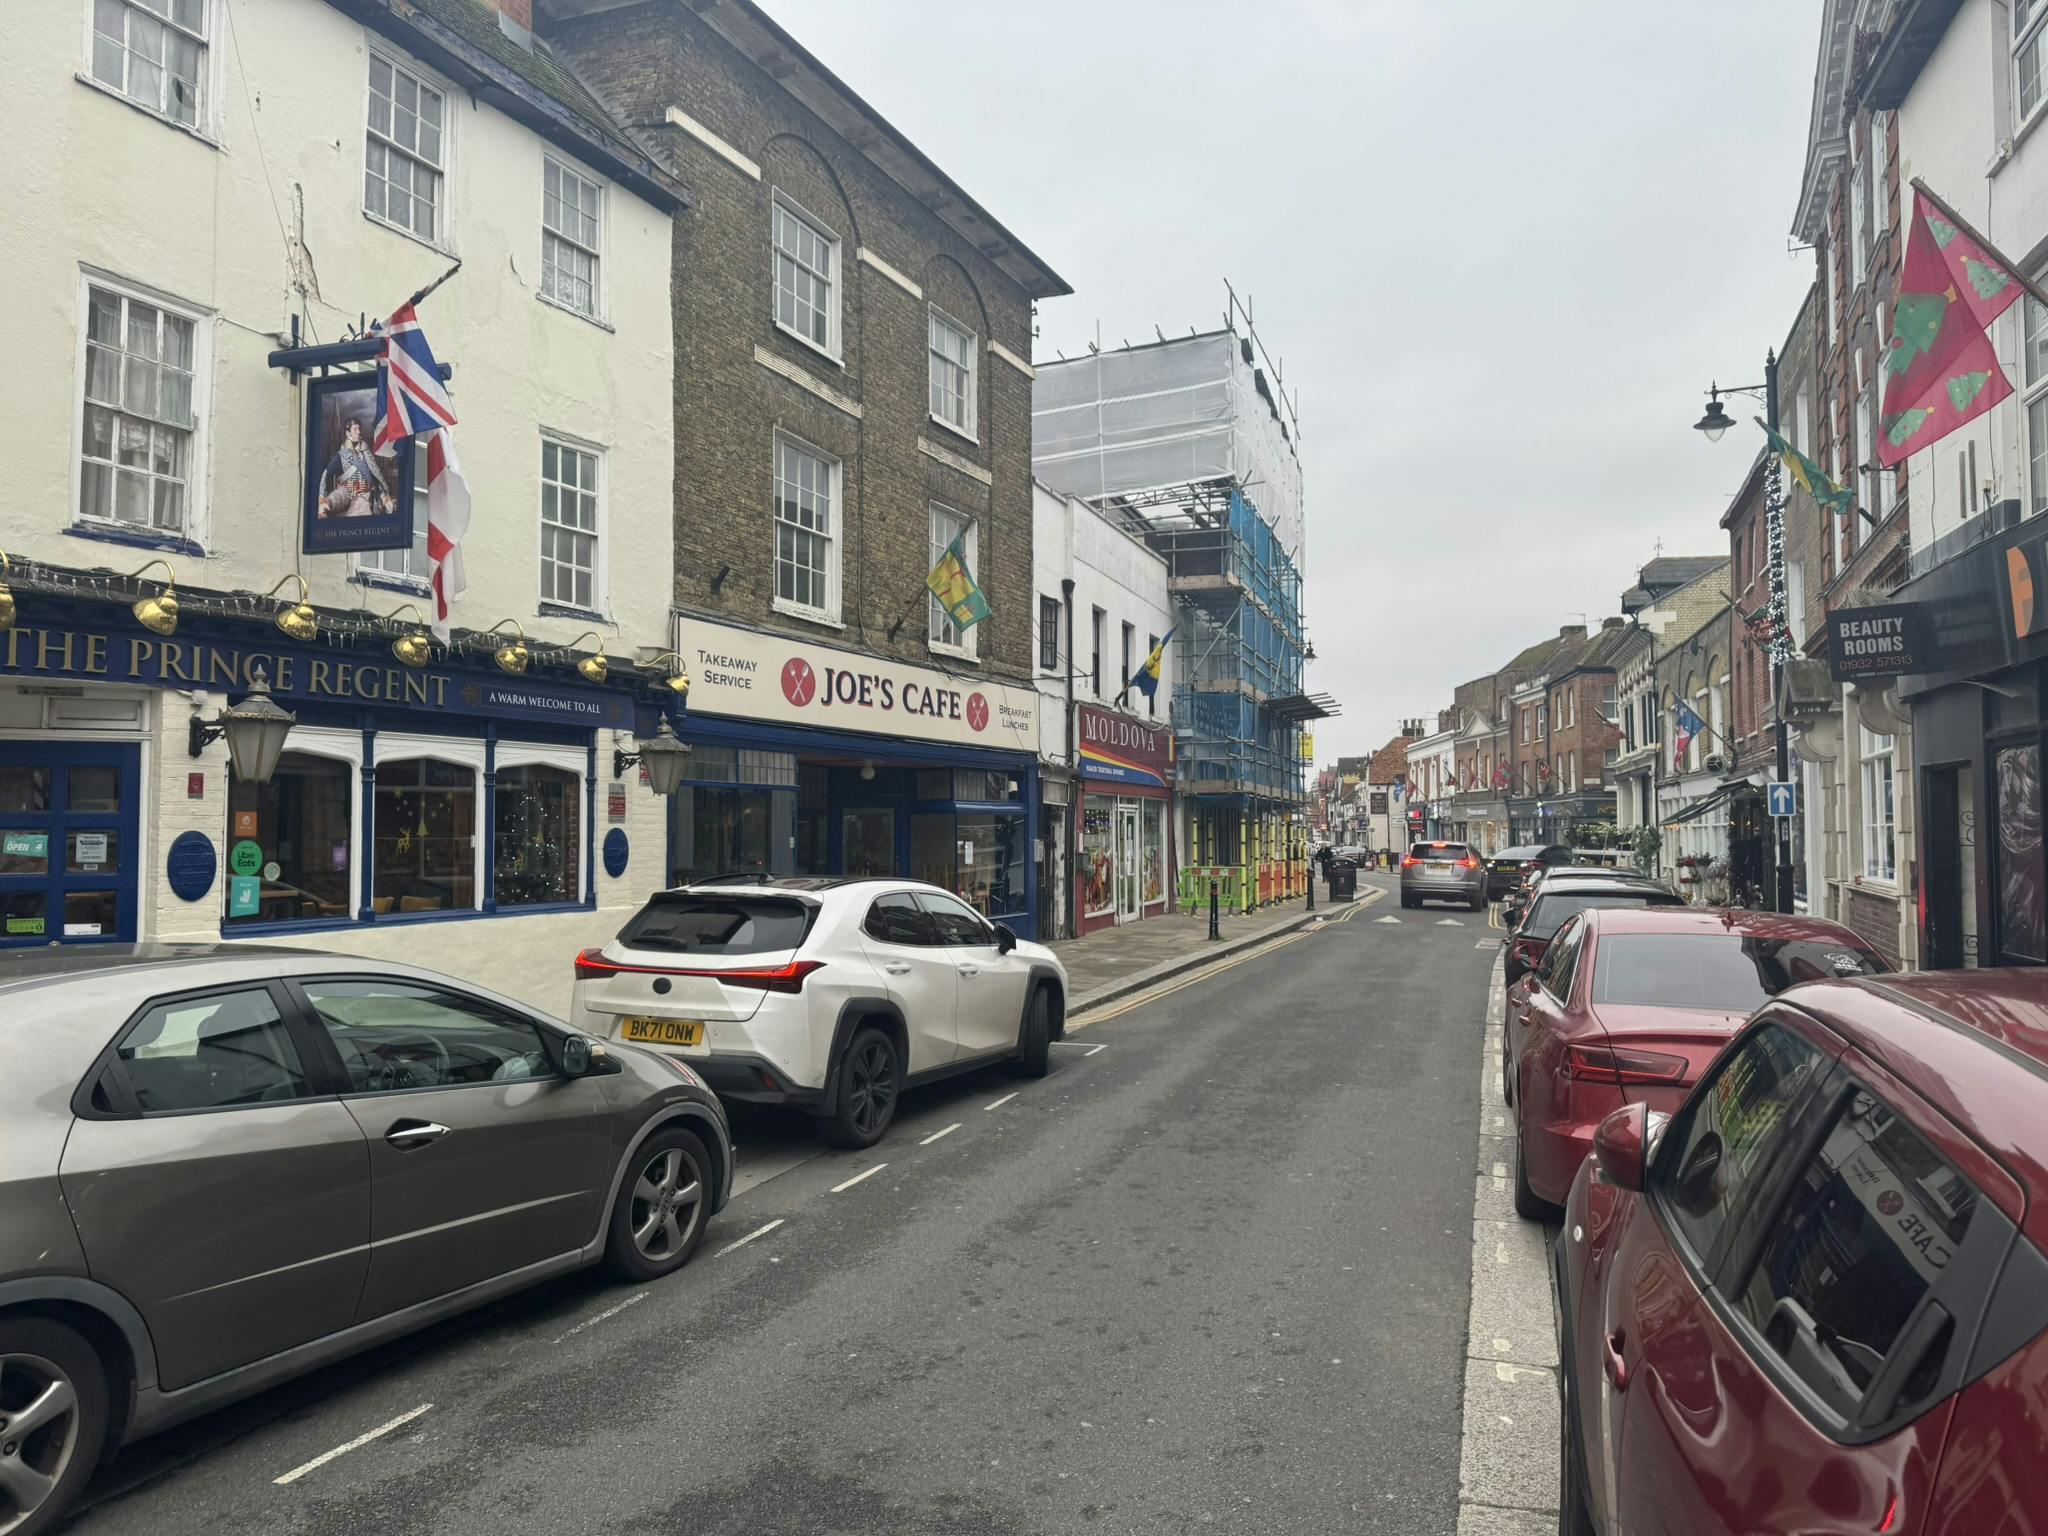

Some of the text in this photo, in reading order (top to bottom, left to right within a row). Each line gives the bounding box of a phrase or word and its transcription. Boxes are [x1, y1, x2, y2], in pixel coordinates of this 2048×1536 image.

[324, 526, 391, 538] THE PRINCE REGENT
[1840, 617, 1904, 638] BEAUTY
[1844, 636, 1904, 656] ROOMS
[4, 627, 450, 706] THE PRINCE REGENT
[697, 649, 758, 673] TAKEAWAY
[1840, 654, 1913, 671] 01932 571313
[704, 670, 752, 690] SERVICE
[489, 692, 601, 714] A WARM WELCOME TO ALL
[821, 667, 962, 721] JOE'S CAFE
[999, 704, 1032, 719] BREAKFAST
[1002, 718, 1029, 732] LUNCHES
[1085, 713, 1155, 752] MOLDOVA
[6, 840, 30, 852] OPEN
[237, 850, 256, 859] Uber
[237, 859, 256, 867] Eats
[630, 1020, 695, 1041] BK71 ONW
